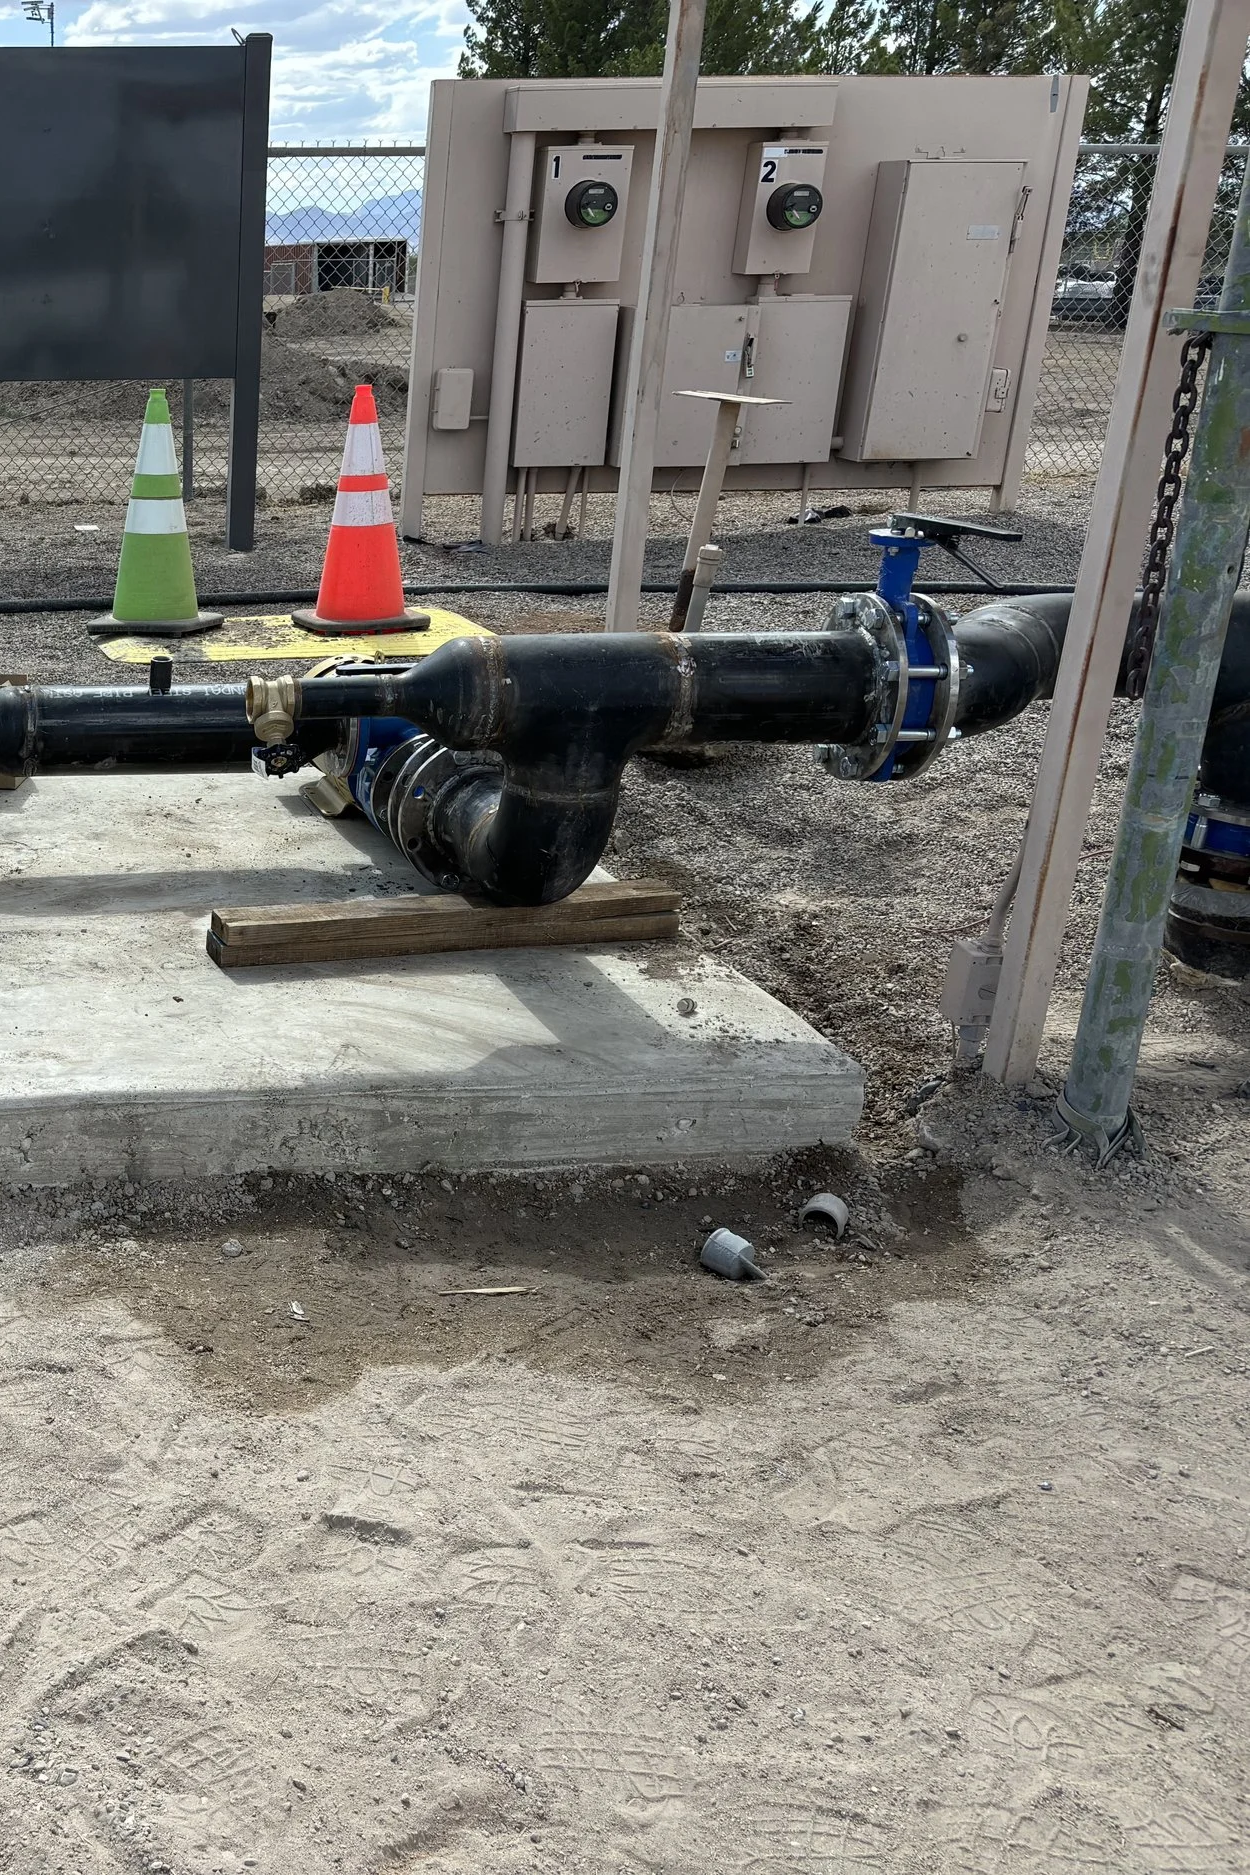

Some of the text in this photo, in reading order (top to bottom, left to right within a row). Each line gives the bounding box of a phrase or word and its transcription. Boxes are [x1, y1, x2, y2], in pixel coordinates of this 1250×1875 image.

[553, 155, 561, 179] 1
[760, 160, 776, 183] 2
[93, 689, 133, 698] PIPE
